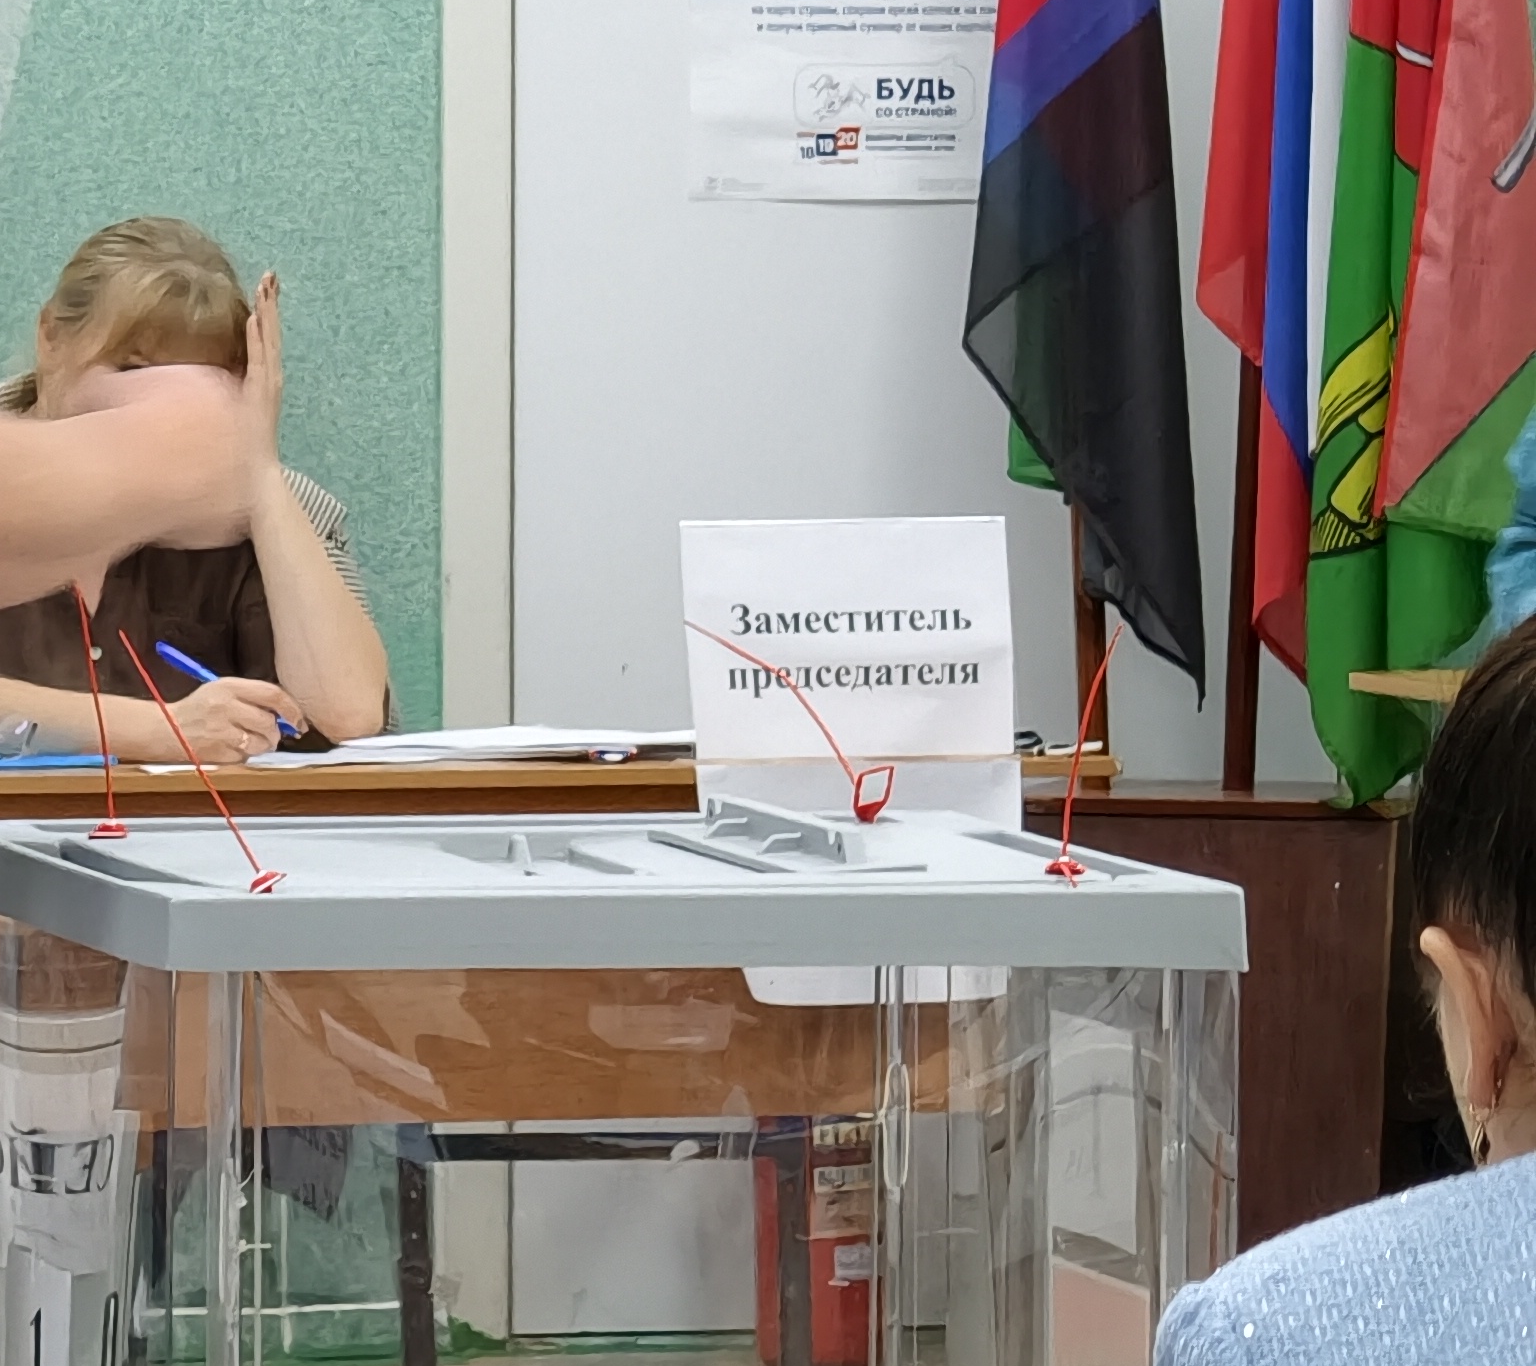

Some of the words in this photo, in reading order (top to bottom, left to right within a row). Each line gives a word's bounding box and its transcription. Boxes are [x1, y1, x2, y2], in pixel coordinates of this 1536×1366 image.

[875, 77, 956, 106] БУДЬ
[836, 132, 857, 147] 20
[729, 604, 973, 636] Заместитель
[727, 661, 980, 699] председателя
